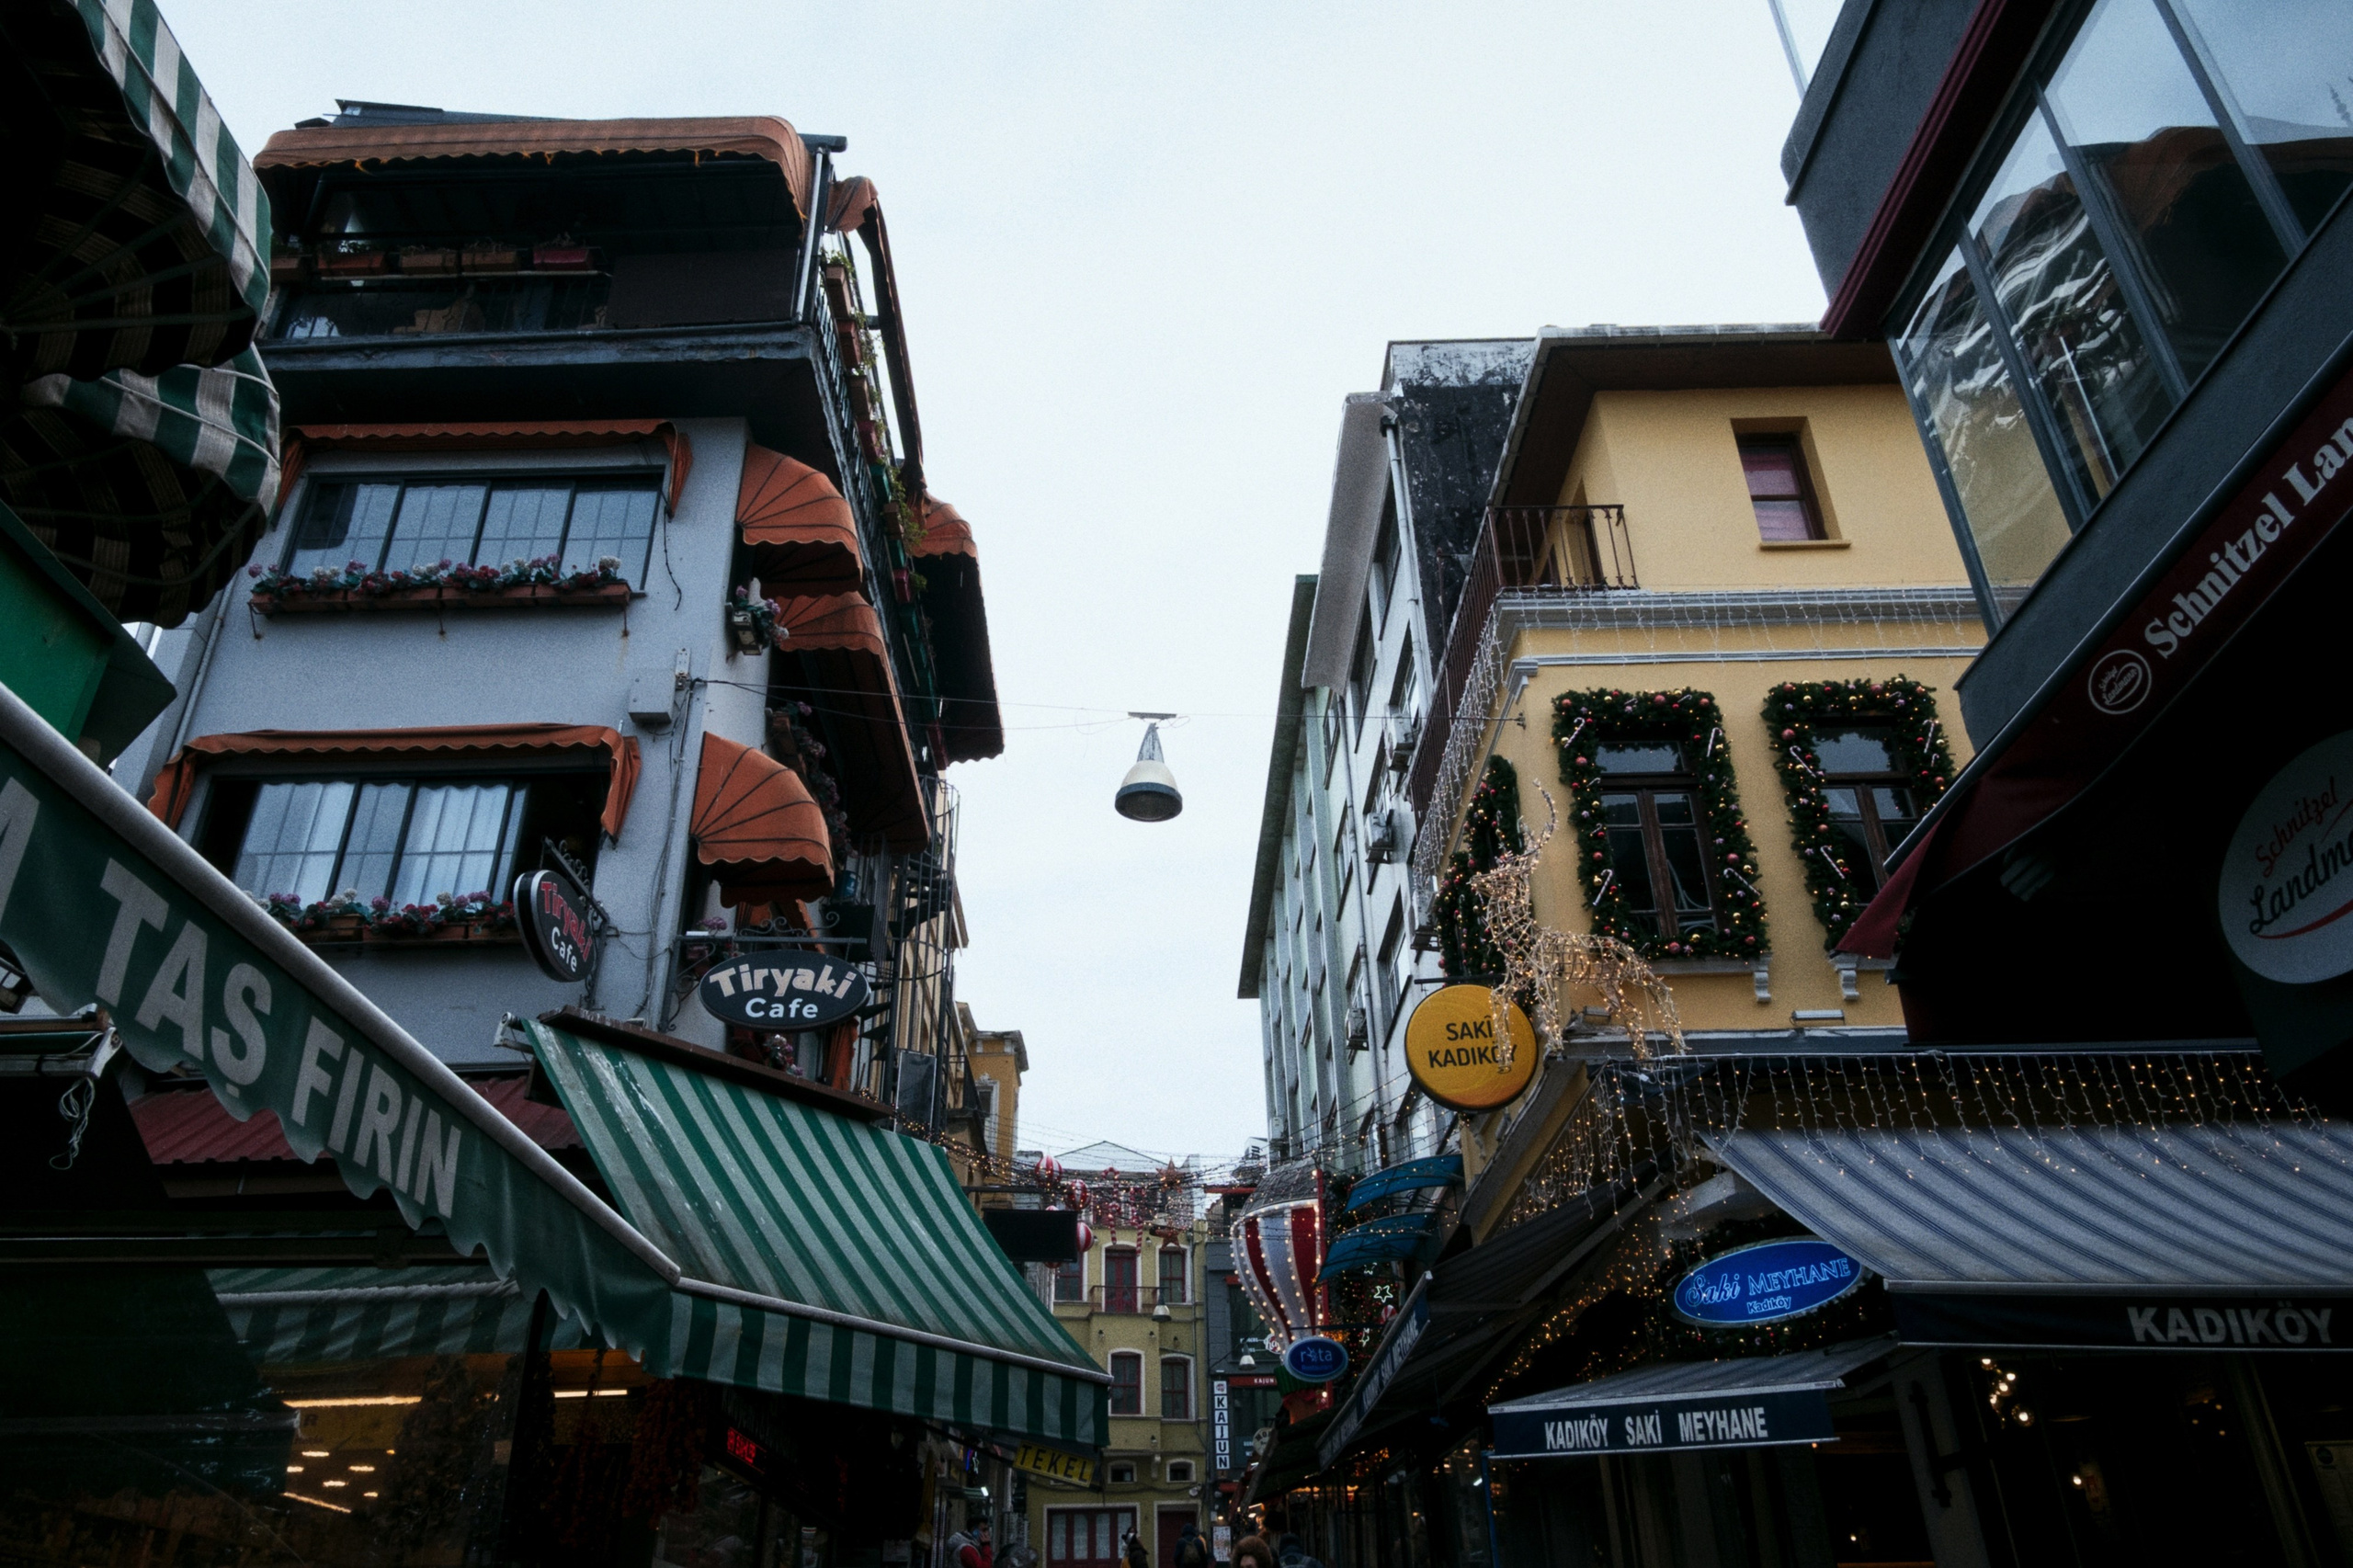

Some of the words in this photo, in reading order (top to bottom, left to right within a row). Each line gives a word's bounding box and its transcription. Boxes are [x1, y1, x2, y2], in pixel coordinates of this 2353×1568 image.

[2144, 492, 2295, 659] Schnitzel
[2256, 776, 2337, 878] Schnitzel
[2250, 829, 2353, 935] Landm
[540, 881, 593, 962] Tiryaki
[551, 926, 577, 972] Cafe
[709, 963, 857, 999] Tiryaki
[745, 997, 818, 1018] Cafe
[96, 858, 271, 1097] TAŞ
[290, 1015, 461, 1219] FIRIN
[1686, 1273, 1741, 1307] Saki
[1748, 1257, 1851, 1297] MEYHANE
[2126, 1300, 2333, 1344] KADIKÖY
[1217, 1396, 1227, 1468] KAJUN
[1544, 1414, 1608, 1449] KADIKÖY
[1624, 1409, 1663, 1446] SAKİ
[1677, 1407, 1768, 1442] MEYHANE
[1020, 1444, 1087, 1482] TEKEL
